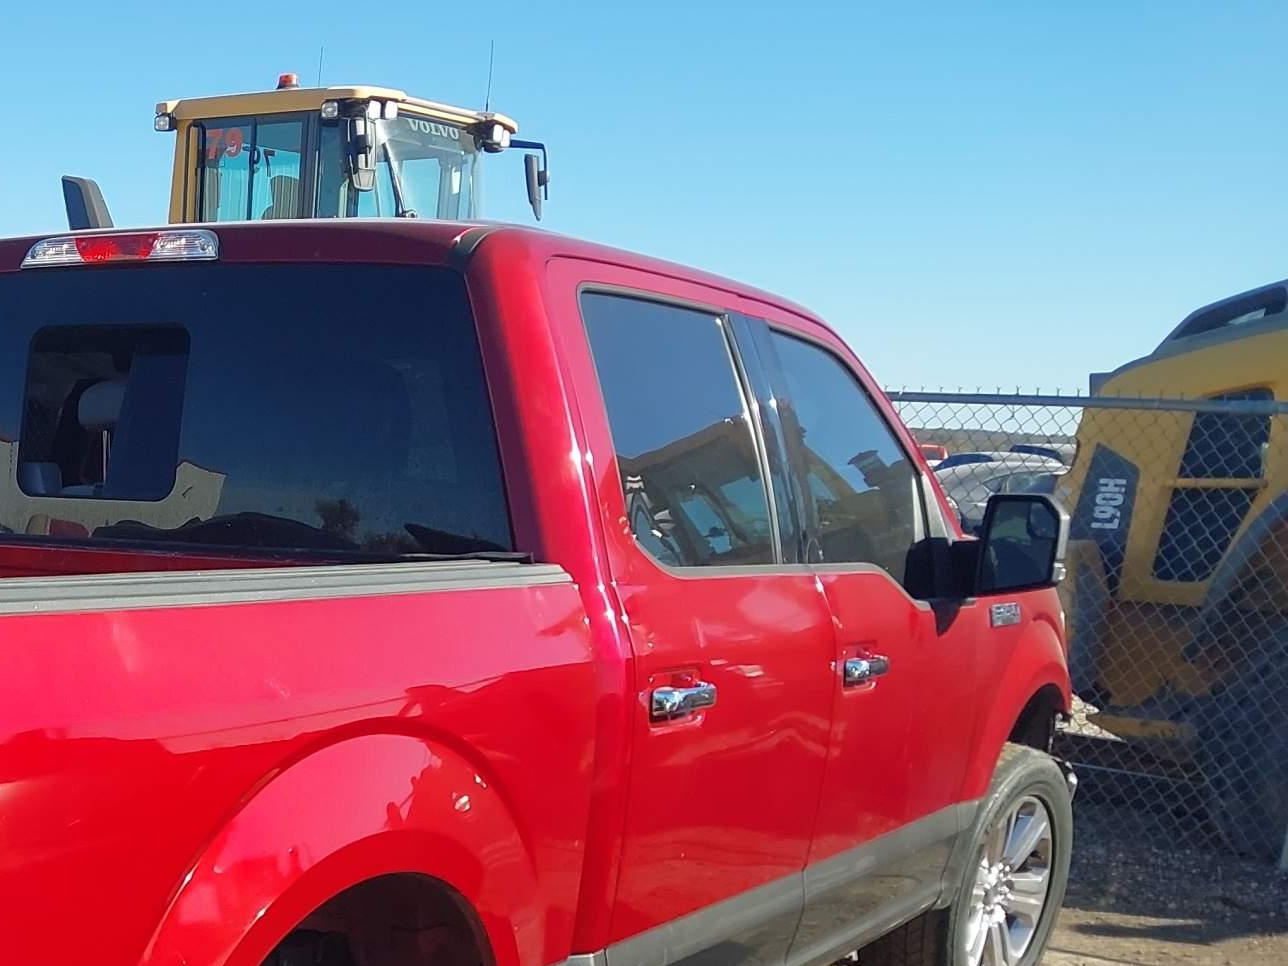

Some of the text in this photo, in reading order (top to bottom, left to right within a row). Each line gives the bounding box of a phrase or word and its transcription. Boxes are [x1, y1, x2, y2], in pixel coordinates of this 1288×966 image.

[206, 127, 243, 158] 79
[406, 118, 460, 140] VOLVO
[1091, 479, 1127, 528] L90H
